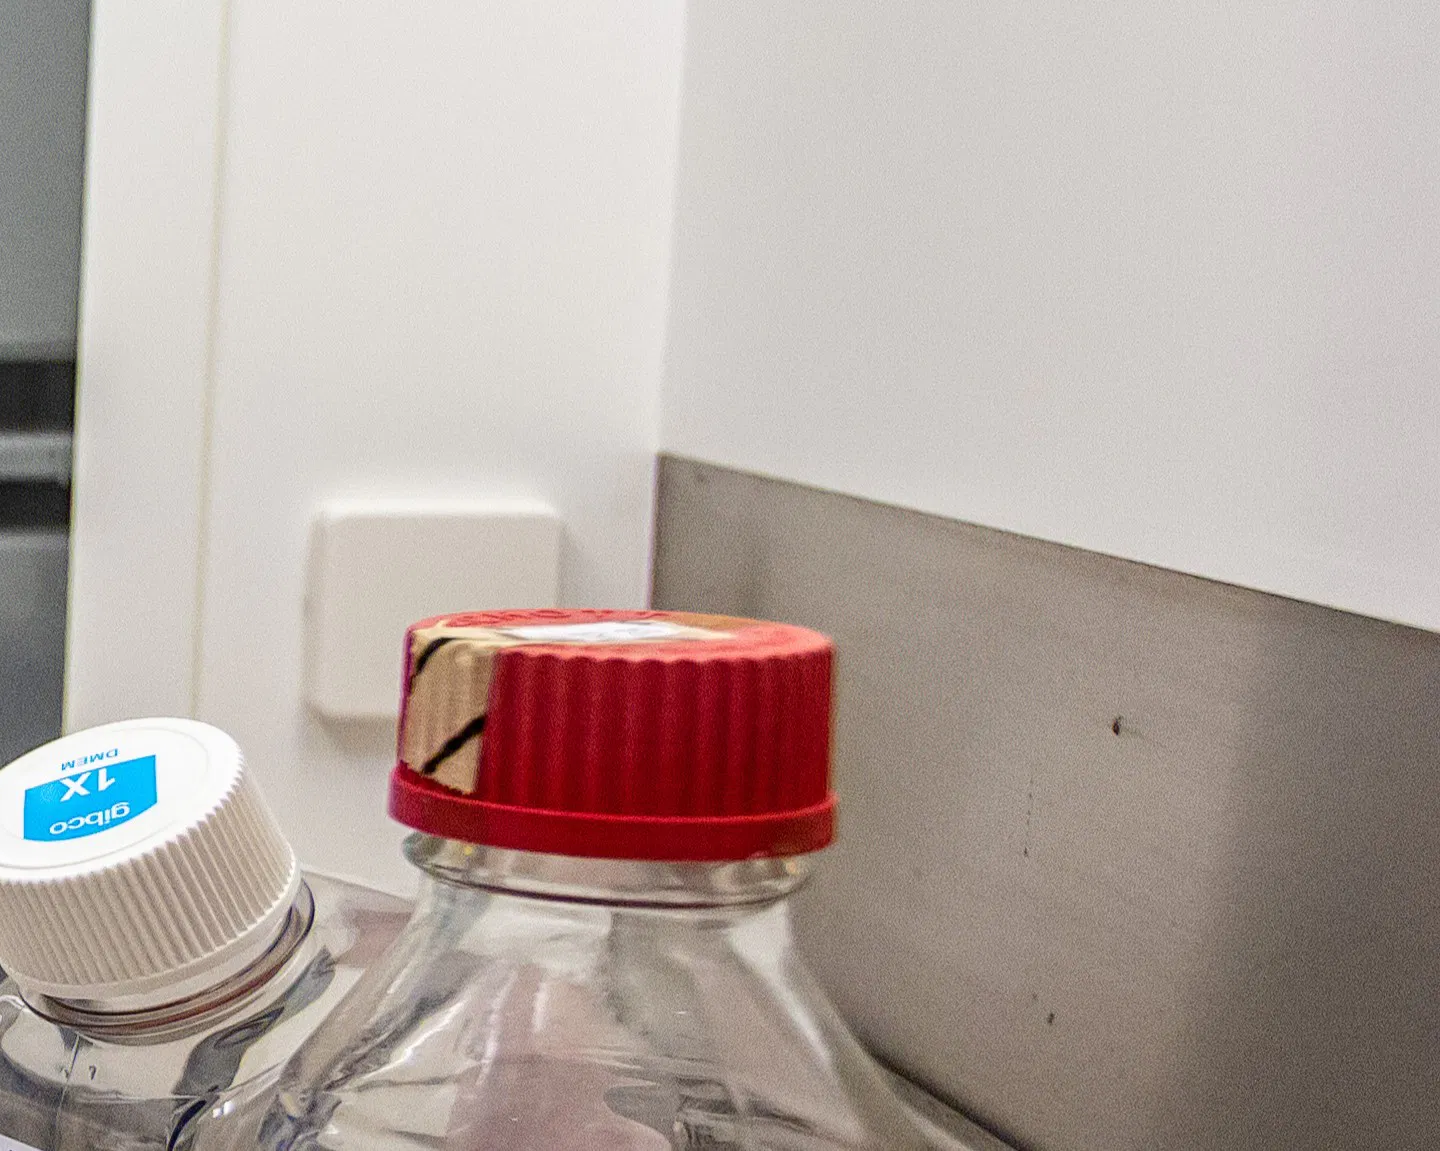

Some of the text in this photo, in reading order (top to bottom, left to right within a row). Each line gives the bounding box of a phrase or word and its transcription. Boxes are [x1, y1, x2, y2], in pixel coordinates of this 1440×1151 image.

[61, 748, 119, 771] DMEM
[59, 768, 116, 802] 1X
[49, 801, 131, 835] gibco
